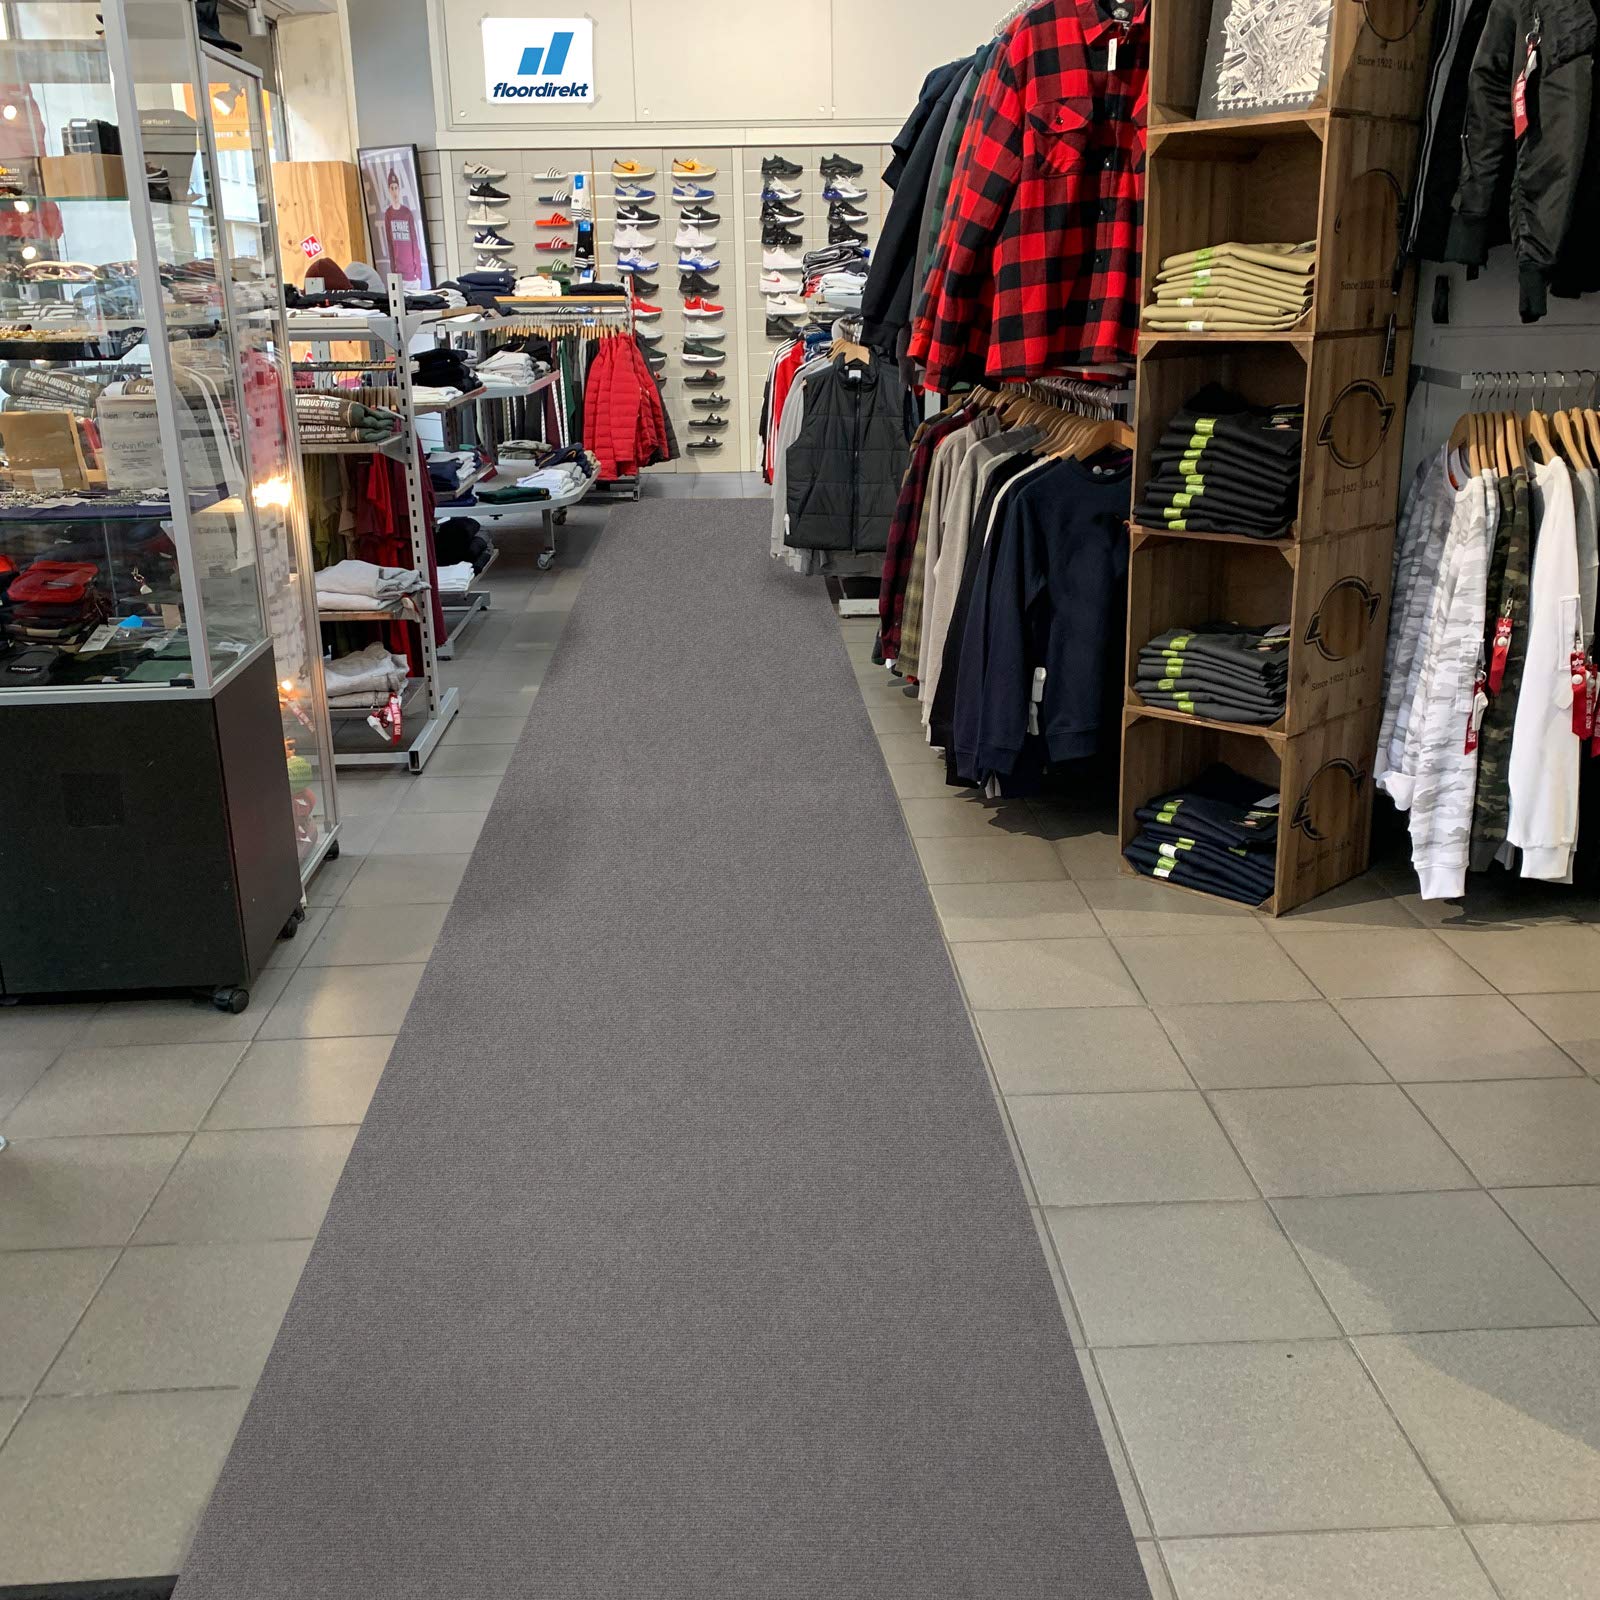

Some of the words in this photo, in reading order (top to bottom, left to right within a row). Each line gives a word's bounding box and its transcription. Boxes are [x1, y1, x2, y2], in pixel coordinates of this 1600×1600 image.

[1357, 55, 1376, 66] Since
[1377, 56, 1392, 70] 1922
[493, 82, 589, 98] floordirekt
[25, 370, 49, 383] ALPHA
[48, 376, 92, 398] INDUSTRIES
[299, 398, 341, 409] INDUSTRIES
